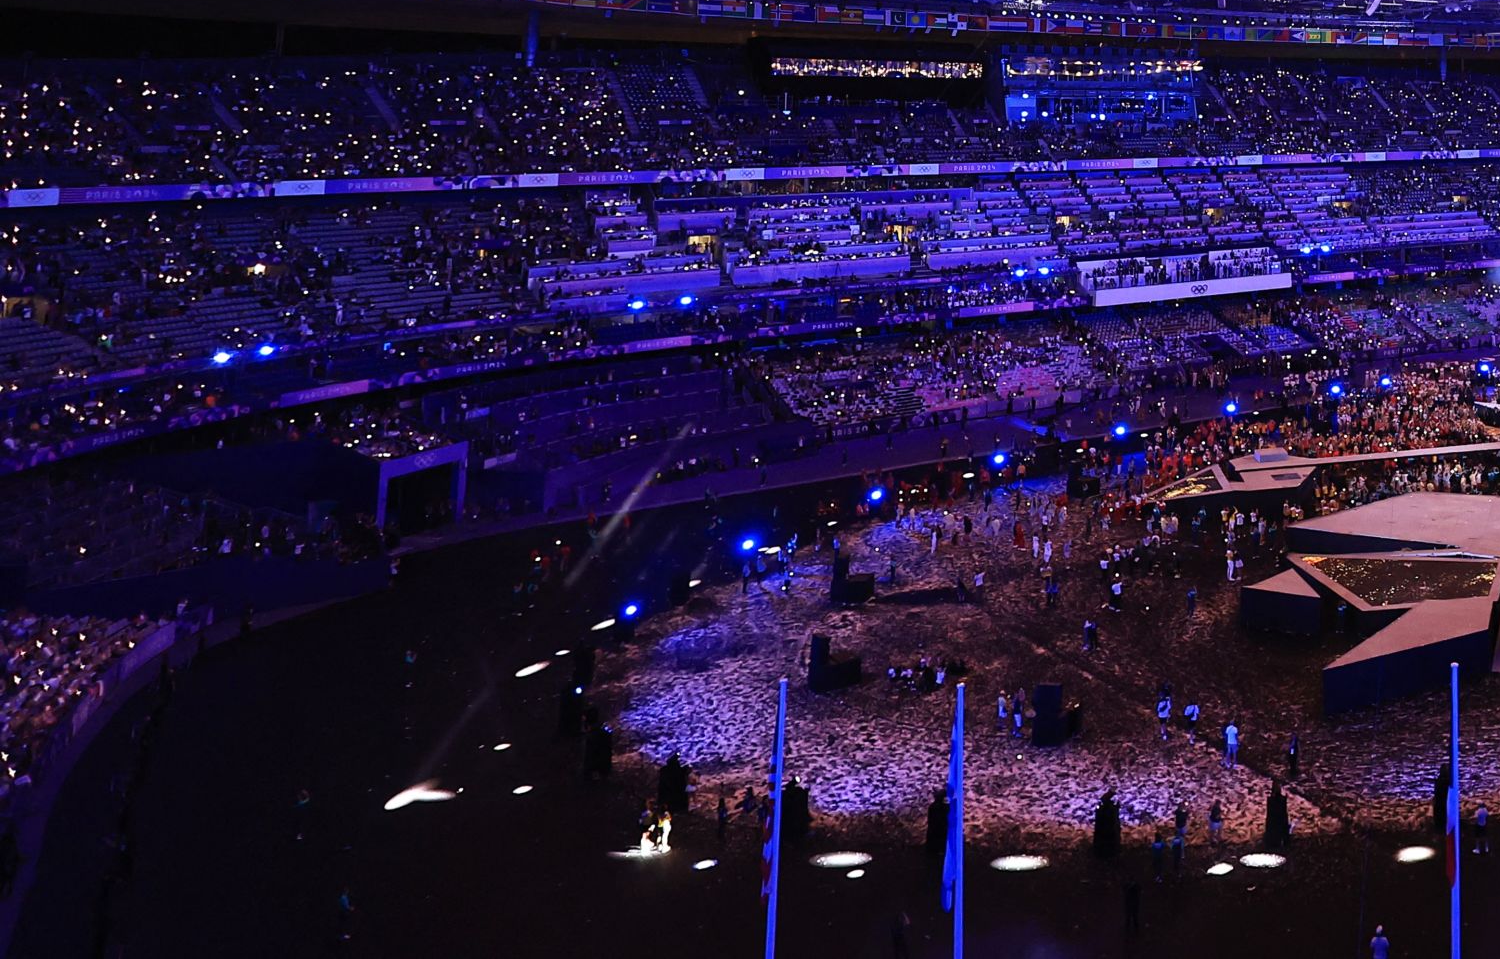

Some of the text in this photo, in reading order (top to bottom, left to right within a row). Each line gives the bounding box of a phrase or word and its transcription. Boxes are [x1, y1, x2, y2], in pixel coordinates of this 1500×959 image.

[578, 174, 635, 183] PARIS 2024
[347, 181, 380, 190] PARIS
[85, 190, 121, 201] PARIS
[456, 361, 506, 374] PARIS 2024
[855, 424, 881, 434] 204
